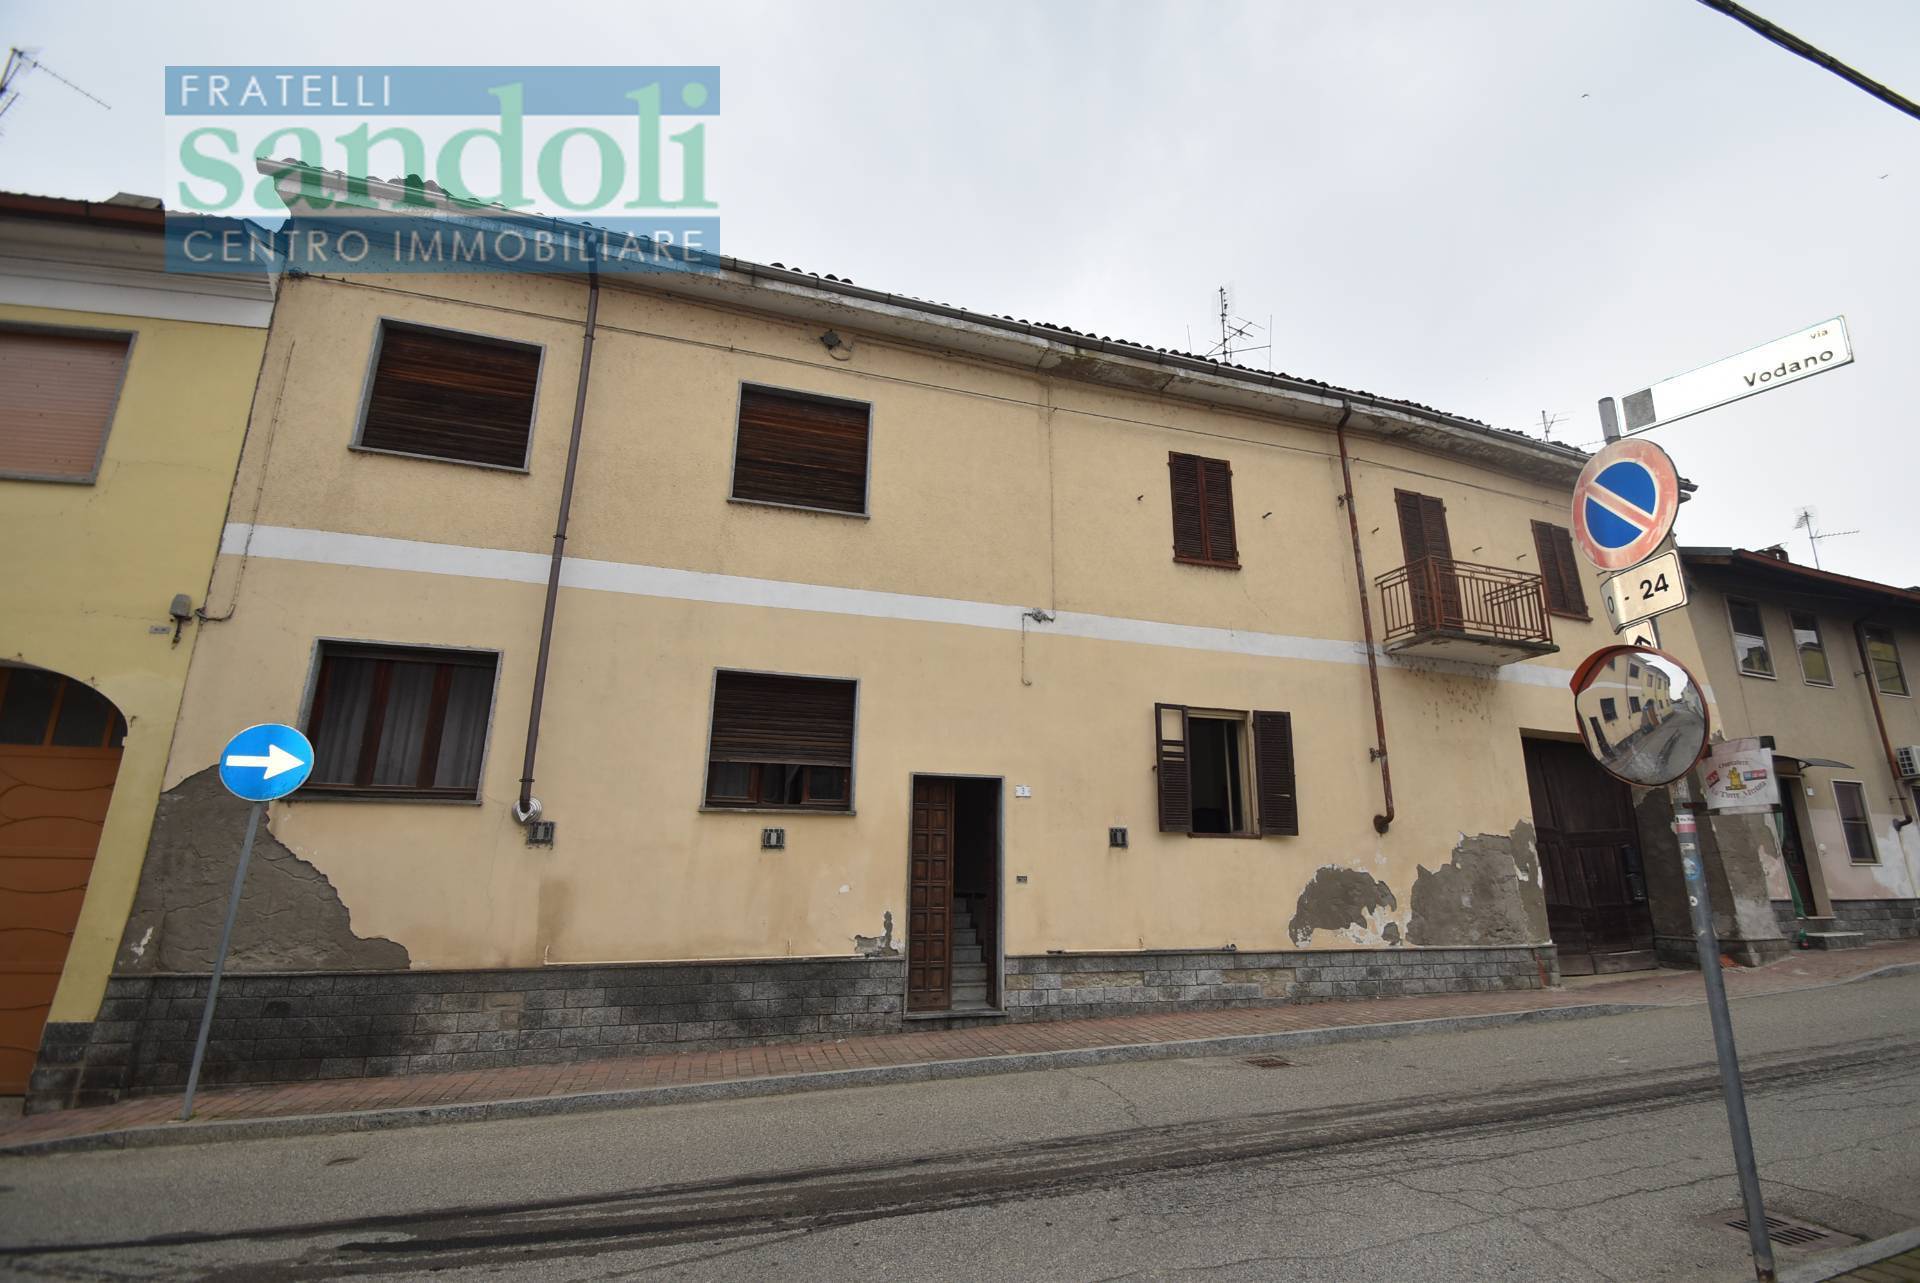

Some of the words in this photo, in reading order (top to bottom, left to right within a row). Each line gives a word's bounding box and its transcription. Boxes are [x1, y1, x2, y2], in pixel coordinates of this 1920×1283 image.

[1810, 329, 1828, 340] via
[1744, 350, 1833, 387] Vodano
[1640, 573, 1669, 600] 24
